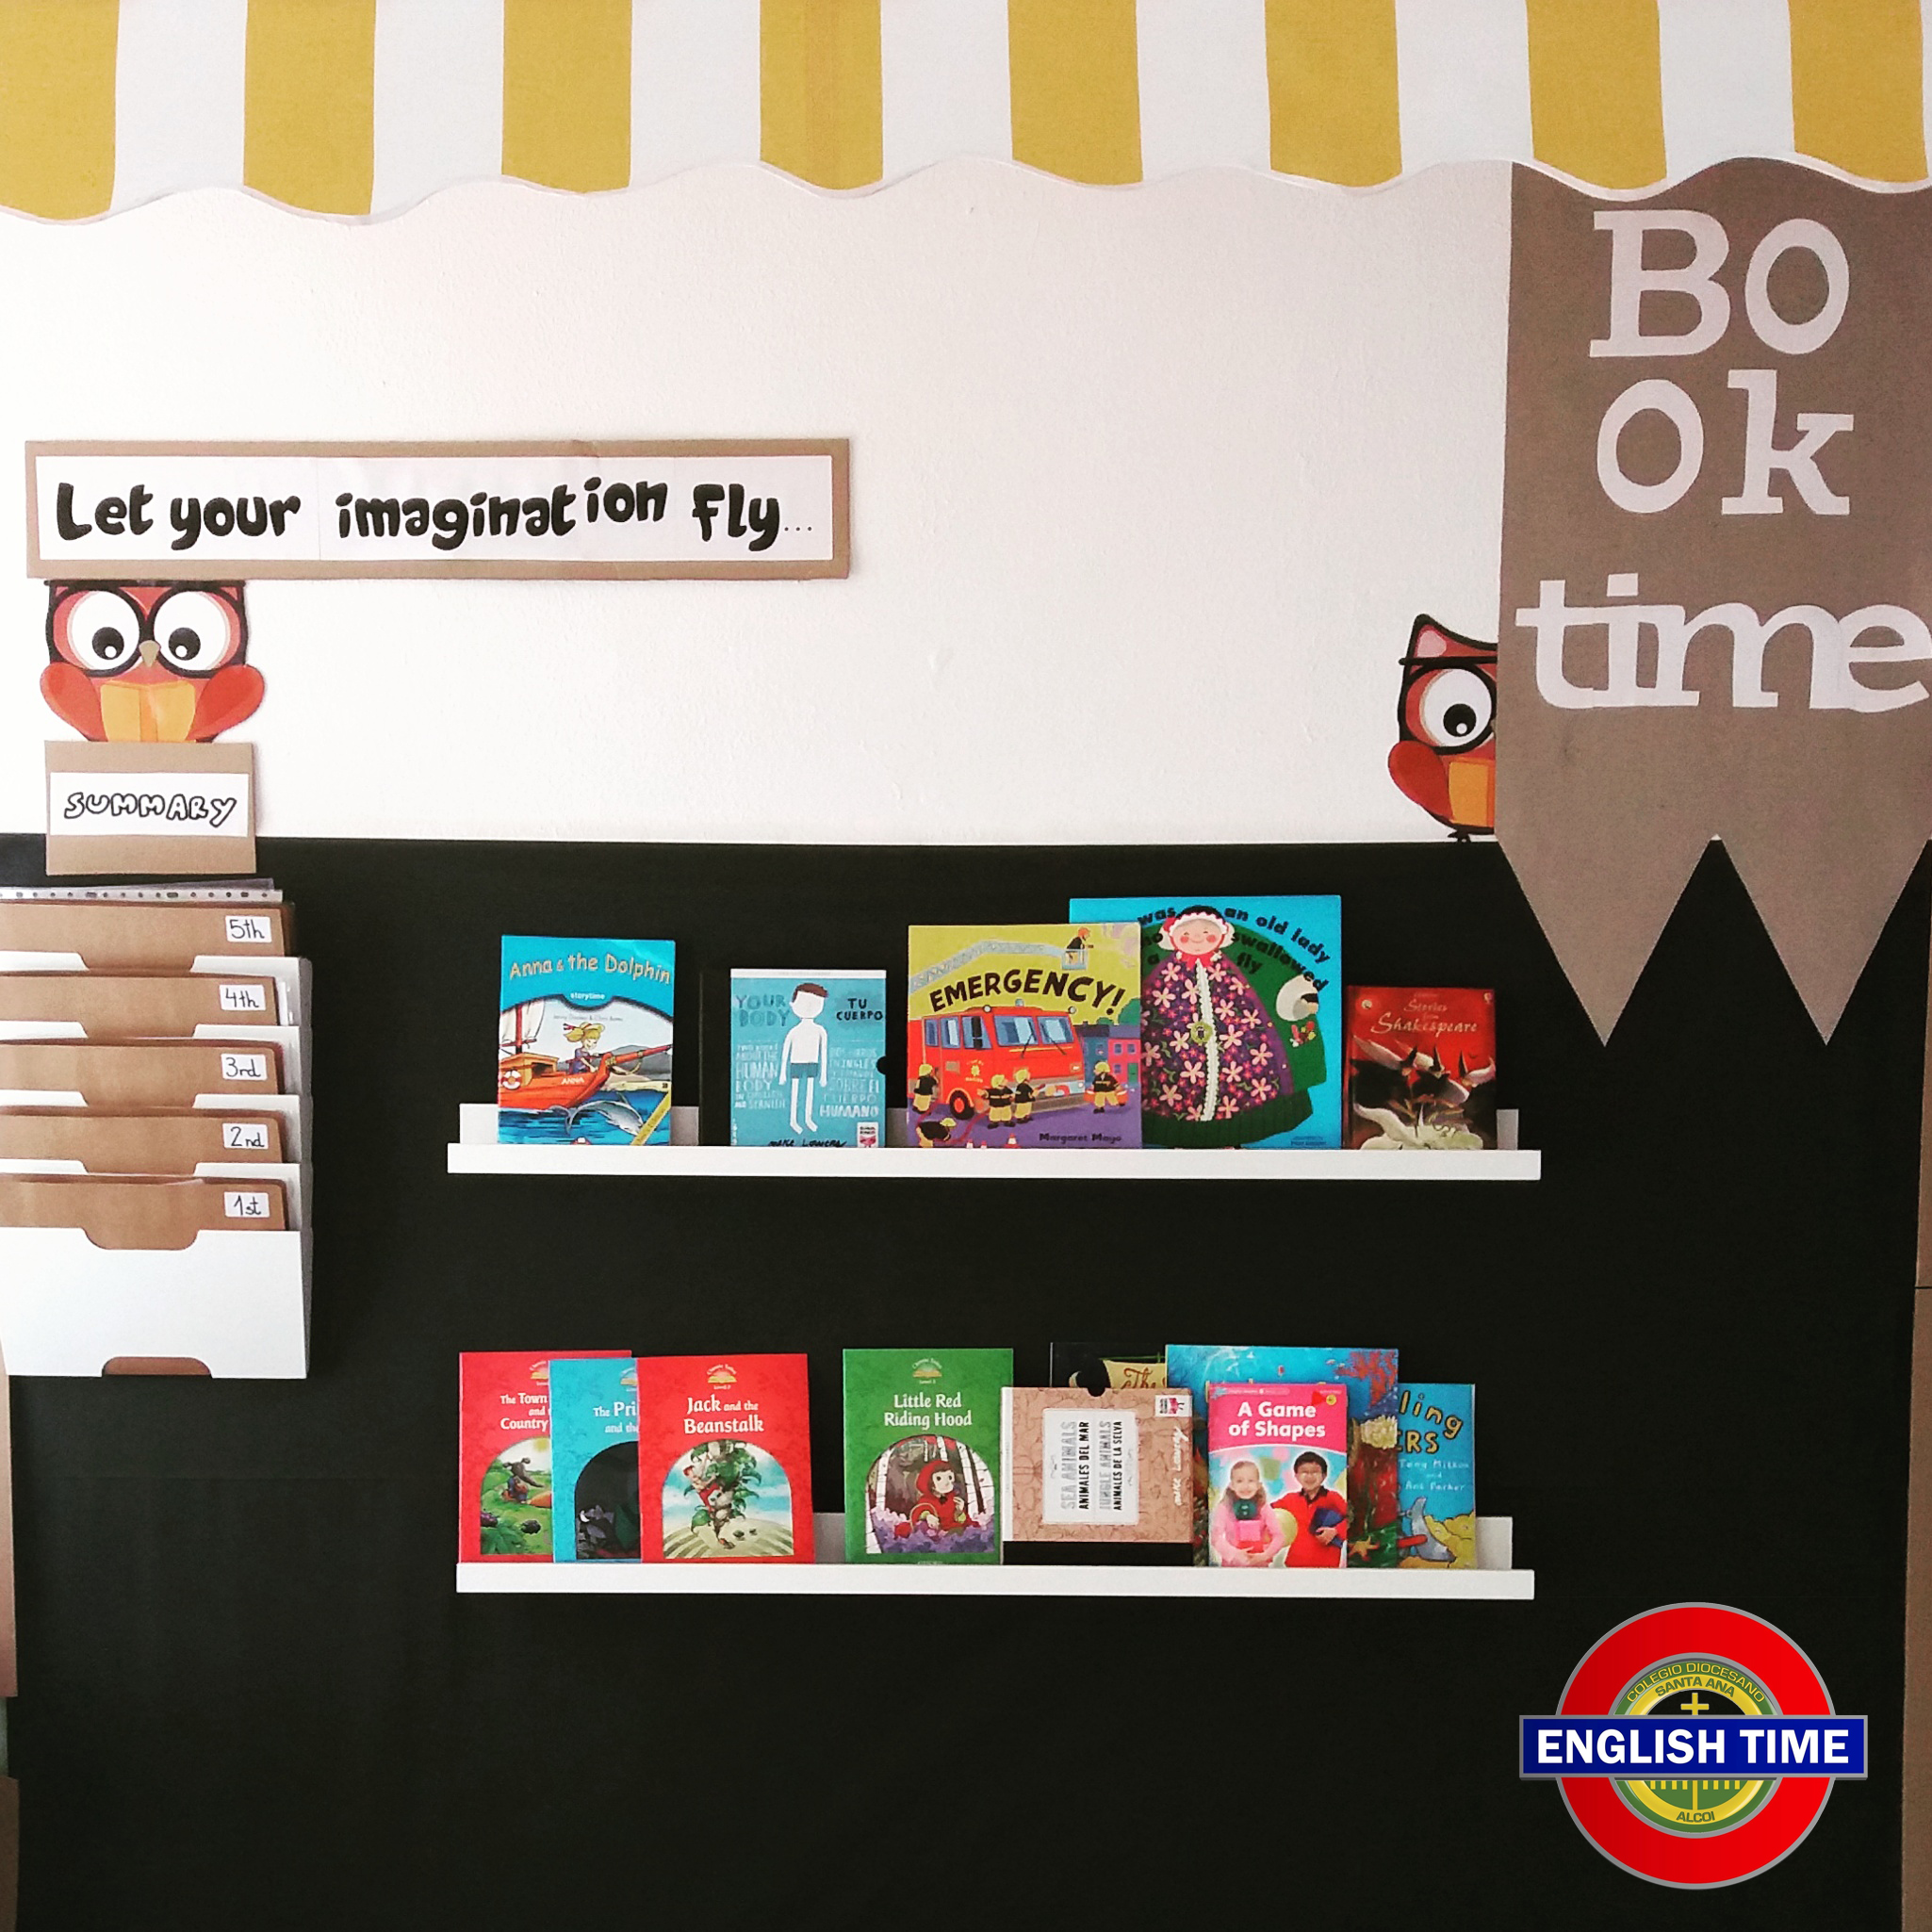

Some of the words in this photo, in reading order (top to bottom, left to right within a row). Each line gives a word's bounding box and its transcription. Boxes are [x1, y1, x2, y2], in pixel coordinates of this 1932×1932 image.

[56, 483, 154, 541] Let
[170, 495, 302, 551] your
[335, 477, 668, 550] imagination
[1515, 573, 1932, 713] time
[63, 791, 237, 827] SUMMARY
[229, 919, 265, 940] 5th
[1138, 908, 1176, 925] was
[1224, 908, 1249, 922] an
[1255, 915, 1289, 935] old
[1291, 927, 1331, 963] lady
[510, 959, 552, 980] Anna
[567, 952, 598, 971] the
[605, 954, 670, 985] Dolphin
[1148, 953, 1160, 965] a
[1236, 952, 1263, 974] fly
[1231, 932, 1329, 991] swallowed
[225, 988, 259, 1008] 4th
[735, 994, 786, 1010] YOUR
[847, 998, 867, 1008] TU
[929, 969, 1126, 1016] EMERGENCY!
[740, 1010, 790, 1026] BODY
[836, 1010, 883, 1021] CUERPO
[1370, 1012, 1477, 1038] Shakespeare
[225, 1056, 262, 1078] 3rd
[819, 1105, 880, 1118] HUMANO
[231, 1127, 265, 1148] 2nd
[1040, 1132, 1087, 1144] Margaret
[1091, 1132, 1122, 1144] Mayo
[234, 1195, 262, 1216] 1st
[1121, 1367, 1155, 1389] The
[500, 1395, 516, 1404] The
[517, 1392, 548, 1404] Town
[687, 1394, 721, 1415] Jack
[724, 1400, 742, 1411] and
[744, 1400, 759, 1411] the
[893, 1391, 931, 1408] Little
[936, 1392, 962, 1408] Red
[528, 1406, 546, 1416] and
[593, 1405, 610, 1416] The
[1237, 1402, 1252, 1417] A
[1258, 1401, 1317, 1417] Game
[500, 1417, 548, 1433] Country
[605, 1422, 623, 1433] and
[683, 1415, 764, 1434] Beanstalk
[884, 1411, 930, 1431] Riding
[935, 1410, 972, 1426] Hood
[1228, 1420, 1250, 1436] of
[1254, 1422, 1326, 1442] Shapes
[1078, 1421, 1089, 1442] MAR
[1112, 1421, 1122, 1445] SELVA
[1061, 1421, 1076, 1480] ANIMALS
[1078, 1445, 1089, 1461] DEL
[1099, 1421, 1112, 1468] ANIMALS
[1112, 1447, 1122, 1456] LA
[1112, 1459, 1122, 1469] DE
[1061, 1484, 1076, 1510] SEA
[1078, 1465, 1089, 1510] ANIMALES
[1099, 1472, 1112, 1510] JUNGLE
[1112, 1471, 1122, 1511] ANIMALES
